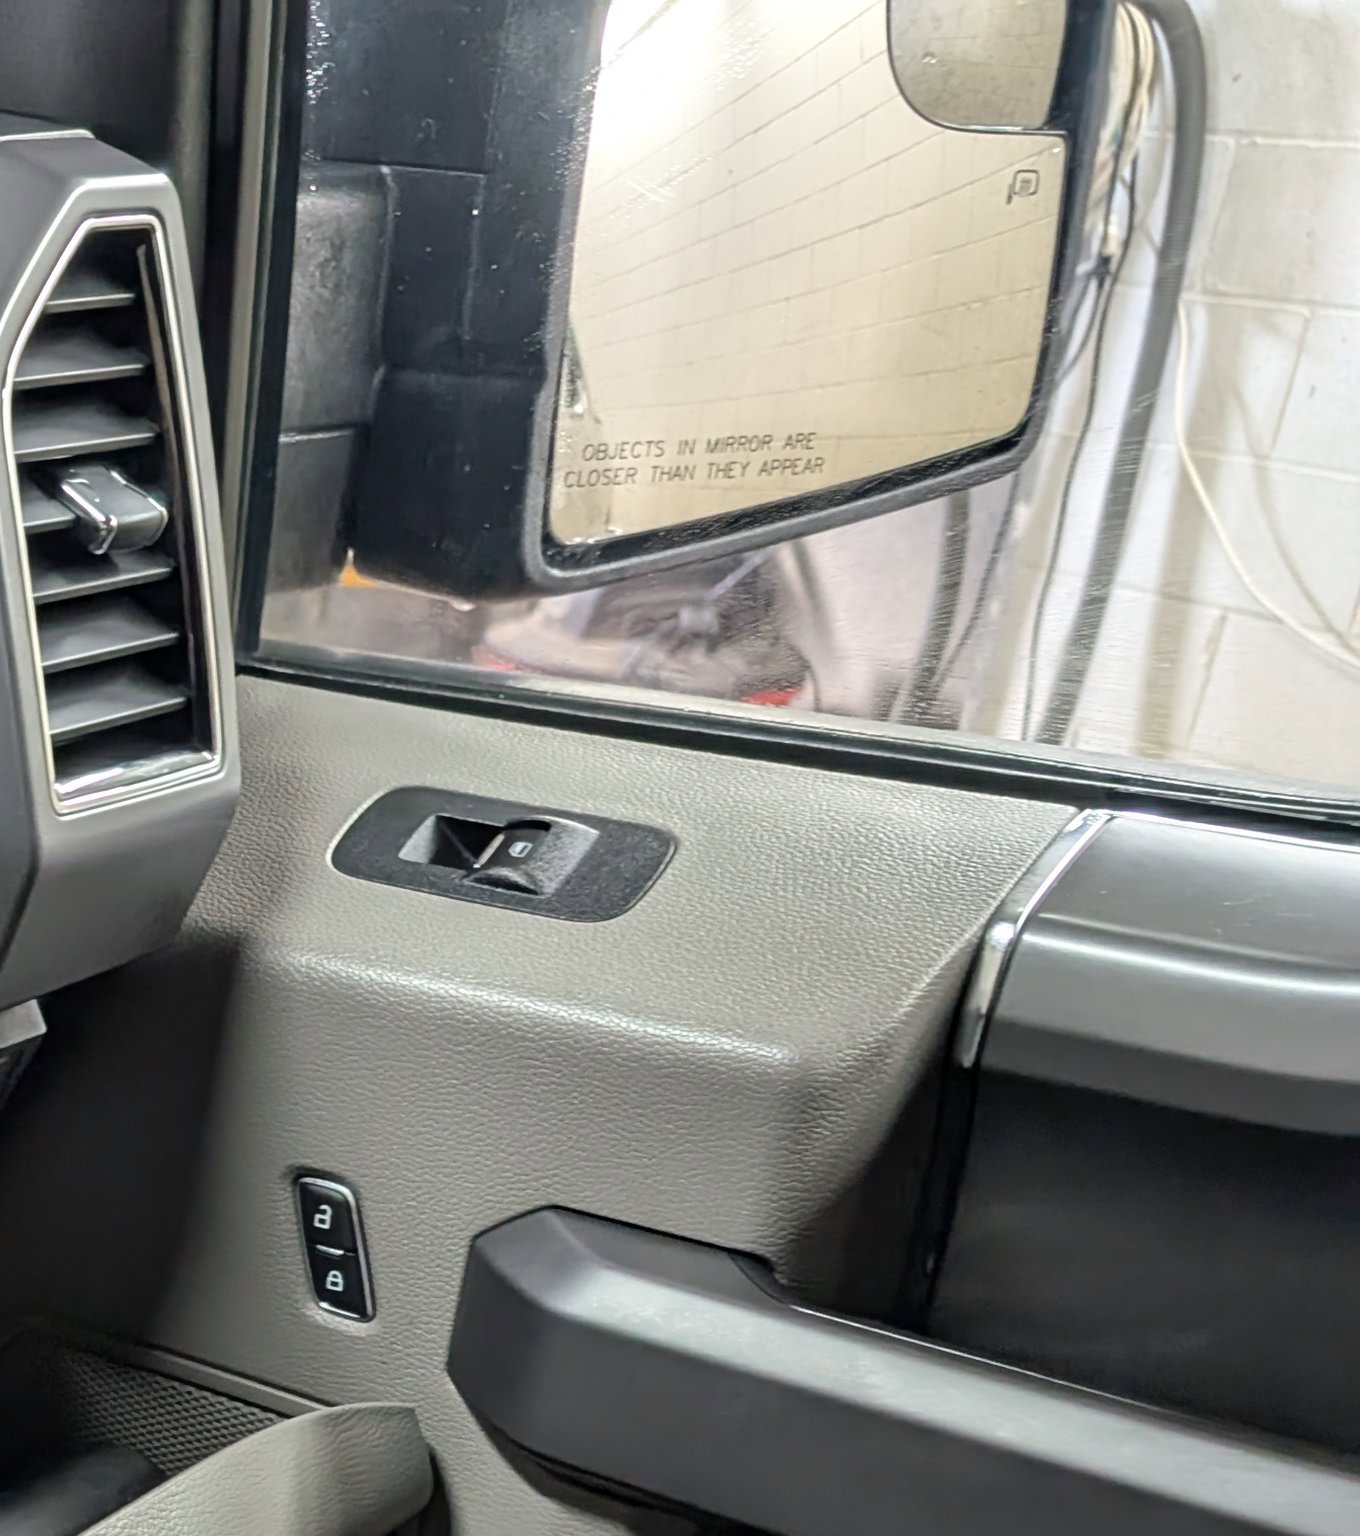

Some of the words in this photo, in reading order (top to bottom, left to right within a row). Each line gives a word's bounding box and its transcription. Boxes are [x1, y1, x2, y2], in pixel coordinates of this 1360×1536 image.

[581, 440, 665, 462] OBJECTS
[676, 439, 697, 456] IN
[705, 434, 775, 454] MIRROR
[783, 432, 817, 450] ARE
[563, 466, 638, 489] CLOSER
[650, 464, 696, 483] THAN
[707, 461, 750, 480] THEY
[757, 457, 827, 477] APPEAR
